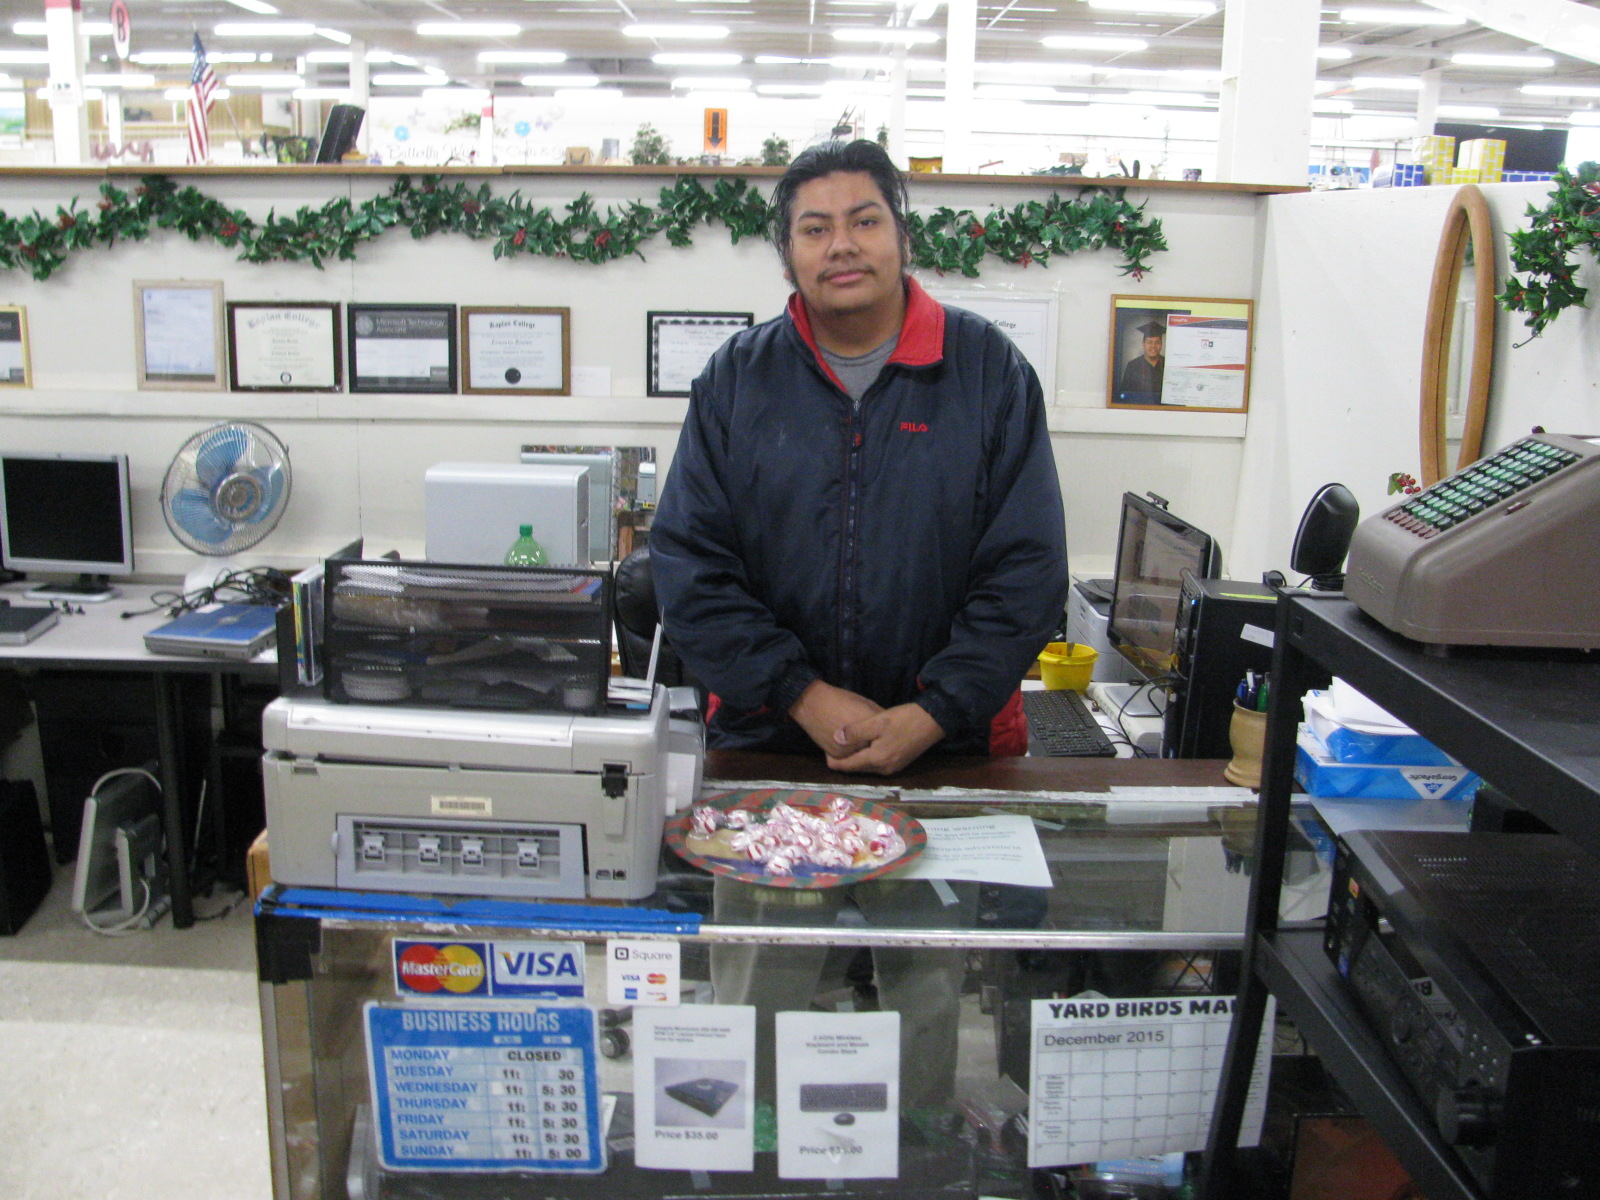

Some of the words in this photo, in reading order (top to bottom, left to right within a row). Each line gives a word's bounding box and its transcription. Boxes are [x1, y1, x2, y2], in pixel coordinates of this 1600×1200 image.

[900, 422, 929, 432] FILA
[632, 950, 672, 962] Square
[402, 961, 482, 977] MasterCard
[502, 952, 577, 977] VISA
[1049, 1003, 1110, 1019] YARD
[1115, 1000, 1182, 1017] BIRDS
[1189, 1000, 1236, 1015] MA
[402, 1011, 492, 1032] BUSINESS
[497, 1012, 560, 1032] HOURS
[1044, 1031, 1121, 1046] December
[1127, 1030, 1164, 1043] 2015
[391, 1049, 450, 1060] MONDAY
[507, 1050, 562, 1061] CLOSED
[394, 1066, 453, 1077] TUESDAY
[558, 1069, 575, 1080] 30
[395, 1082, 478, 1093] WEDNESDAY
[560, 1084, 577, 1095] 30
[396, 1097, 468, 1109] THURSDAY
[561, 1101, 578, 1112] 30
[398, 1113, 444, 1124] FRIDAY
[561, 1117, 578, 1128] 30
[399, 1129, 470, 1140] SATURDAY
[563, 1133, 580, 1144] 30
[655, 1131, 682, 1139] Price
[401, 1144, 455, 1156] SUNDAY
[565, 1148, 582, 1159] 00
[799, 1146, 827, 1155] Price
